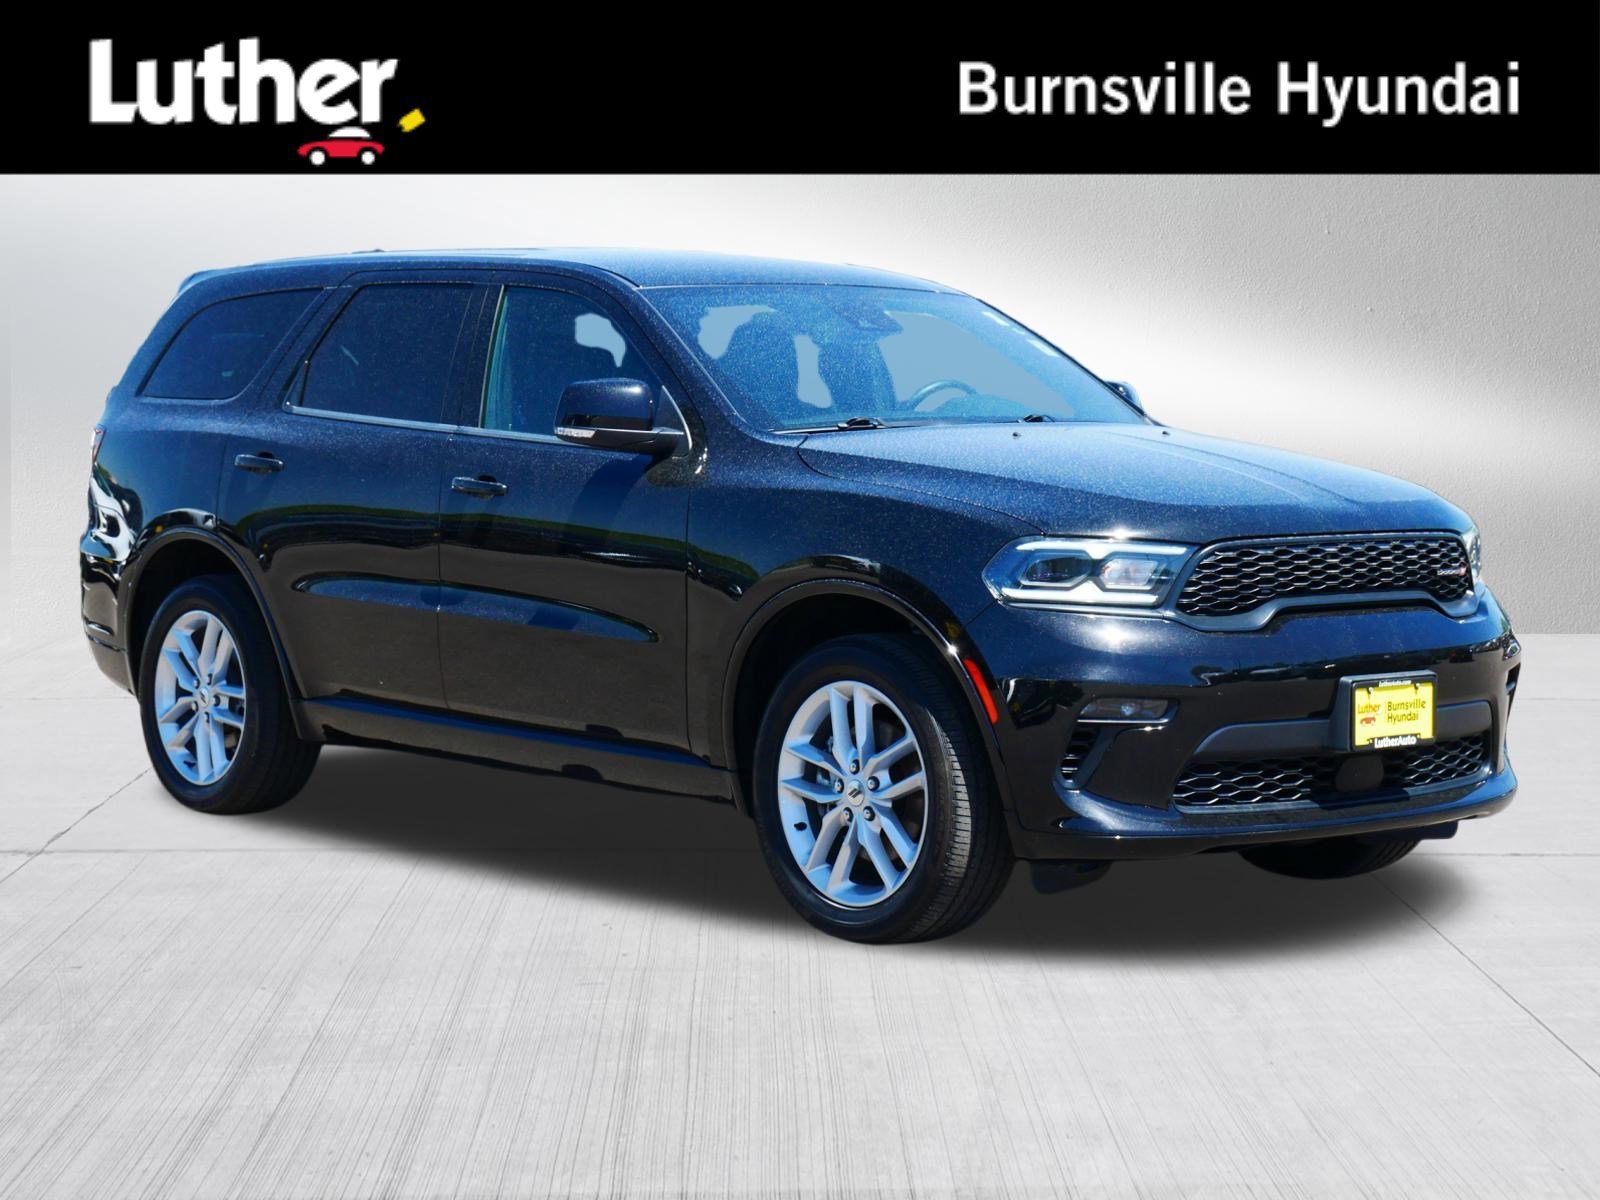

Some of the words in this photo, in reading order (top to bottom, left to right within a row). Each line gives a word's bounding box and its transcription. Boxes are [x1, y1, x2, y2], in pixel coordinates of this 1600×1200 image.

[1358, 704, 1380, 714] Luther
[1387, 700, 1426, 711] Burnsville
[1387, 712, 1419, 725] Hyundai
[1374, 735, 1417, 749] LutherAuto
